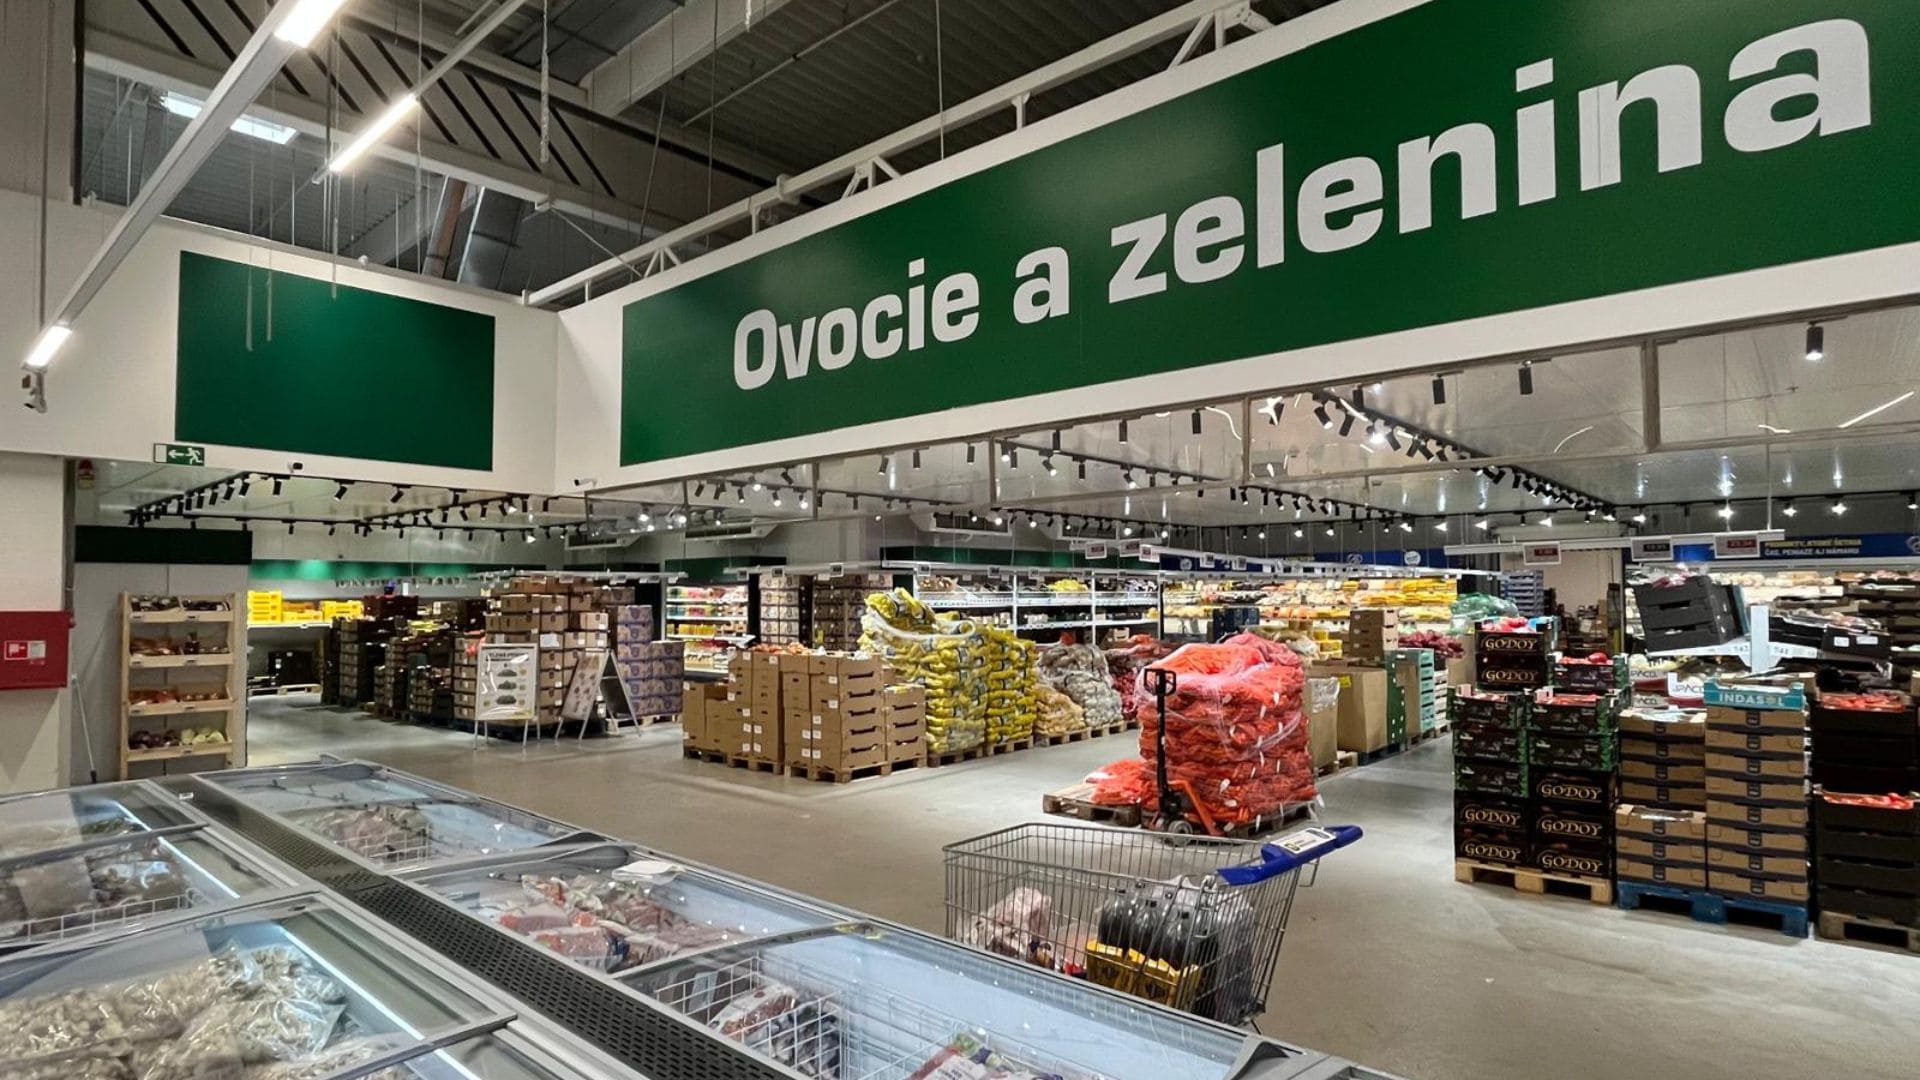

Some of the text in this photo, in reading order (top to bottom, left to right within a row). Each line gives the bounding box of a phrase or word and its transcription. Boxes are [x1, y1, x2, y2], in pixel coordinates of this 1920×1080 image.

[733, 17, 1872, 391] Ovocie a zelenina
[1484, 638, 1537, 651] GODOY
[1485, 669, 1538, 683] GODOY
[1541, 784, 1602, 801] GODOY
[1464, 808, 1521, 826] GODOY
[1541, 819, 1603, 836] GODOY
[1464, 843, 1521, 860] GODOY
[1542, 854, 1603, 872] GODOY
